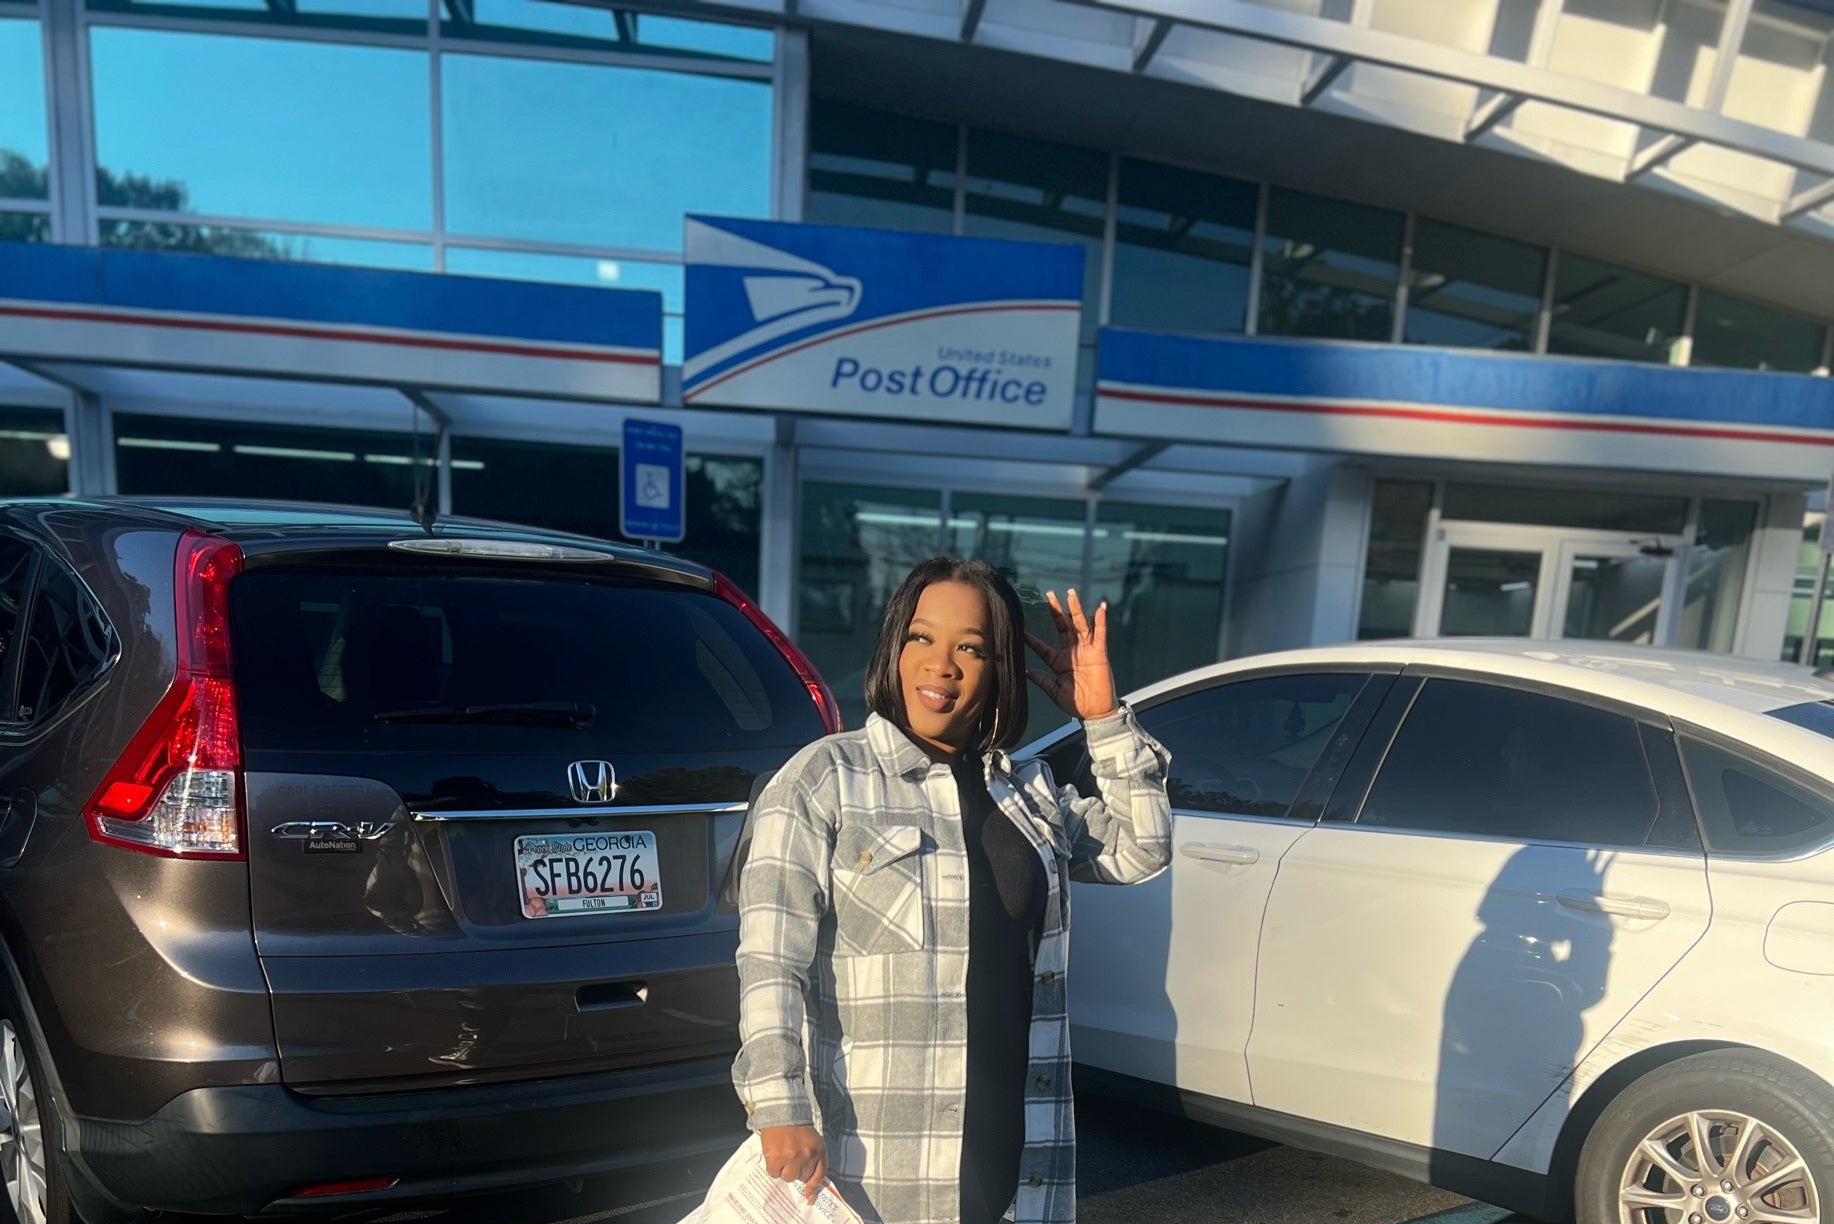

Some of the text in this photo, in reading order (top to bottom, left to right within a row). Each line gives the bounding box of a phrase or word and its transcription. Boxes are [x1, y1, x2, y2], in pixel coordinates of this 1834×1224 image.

[938, 346, 1052, 369] United States
[830, 356, 1047, 406] Post Office
[309, 841, 357, 850] AutoNation
[572, 835, 647, 852] GEORGIA
[532, 853, 645, 897] SFB6276
[582, 898, 606, 909] FULTON
